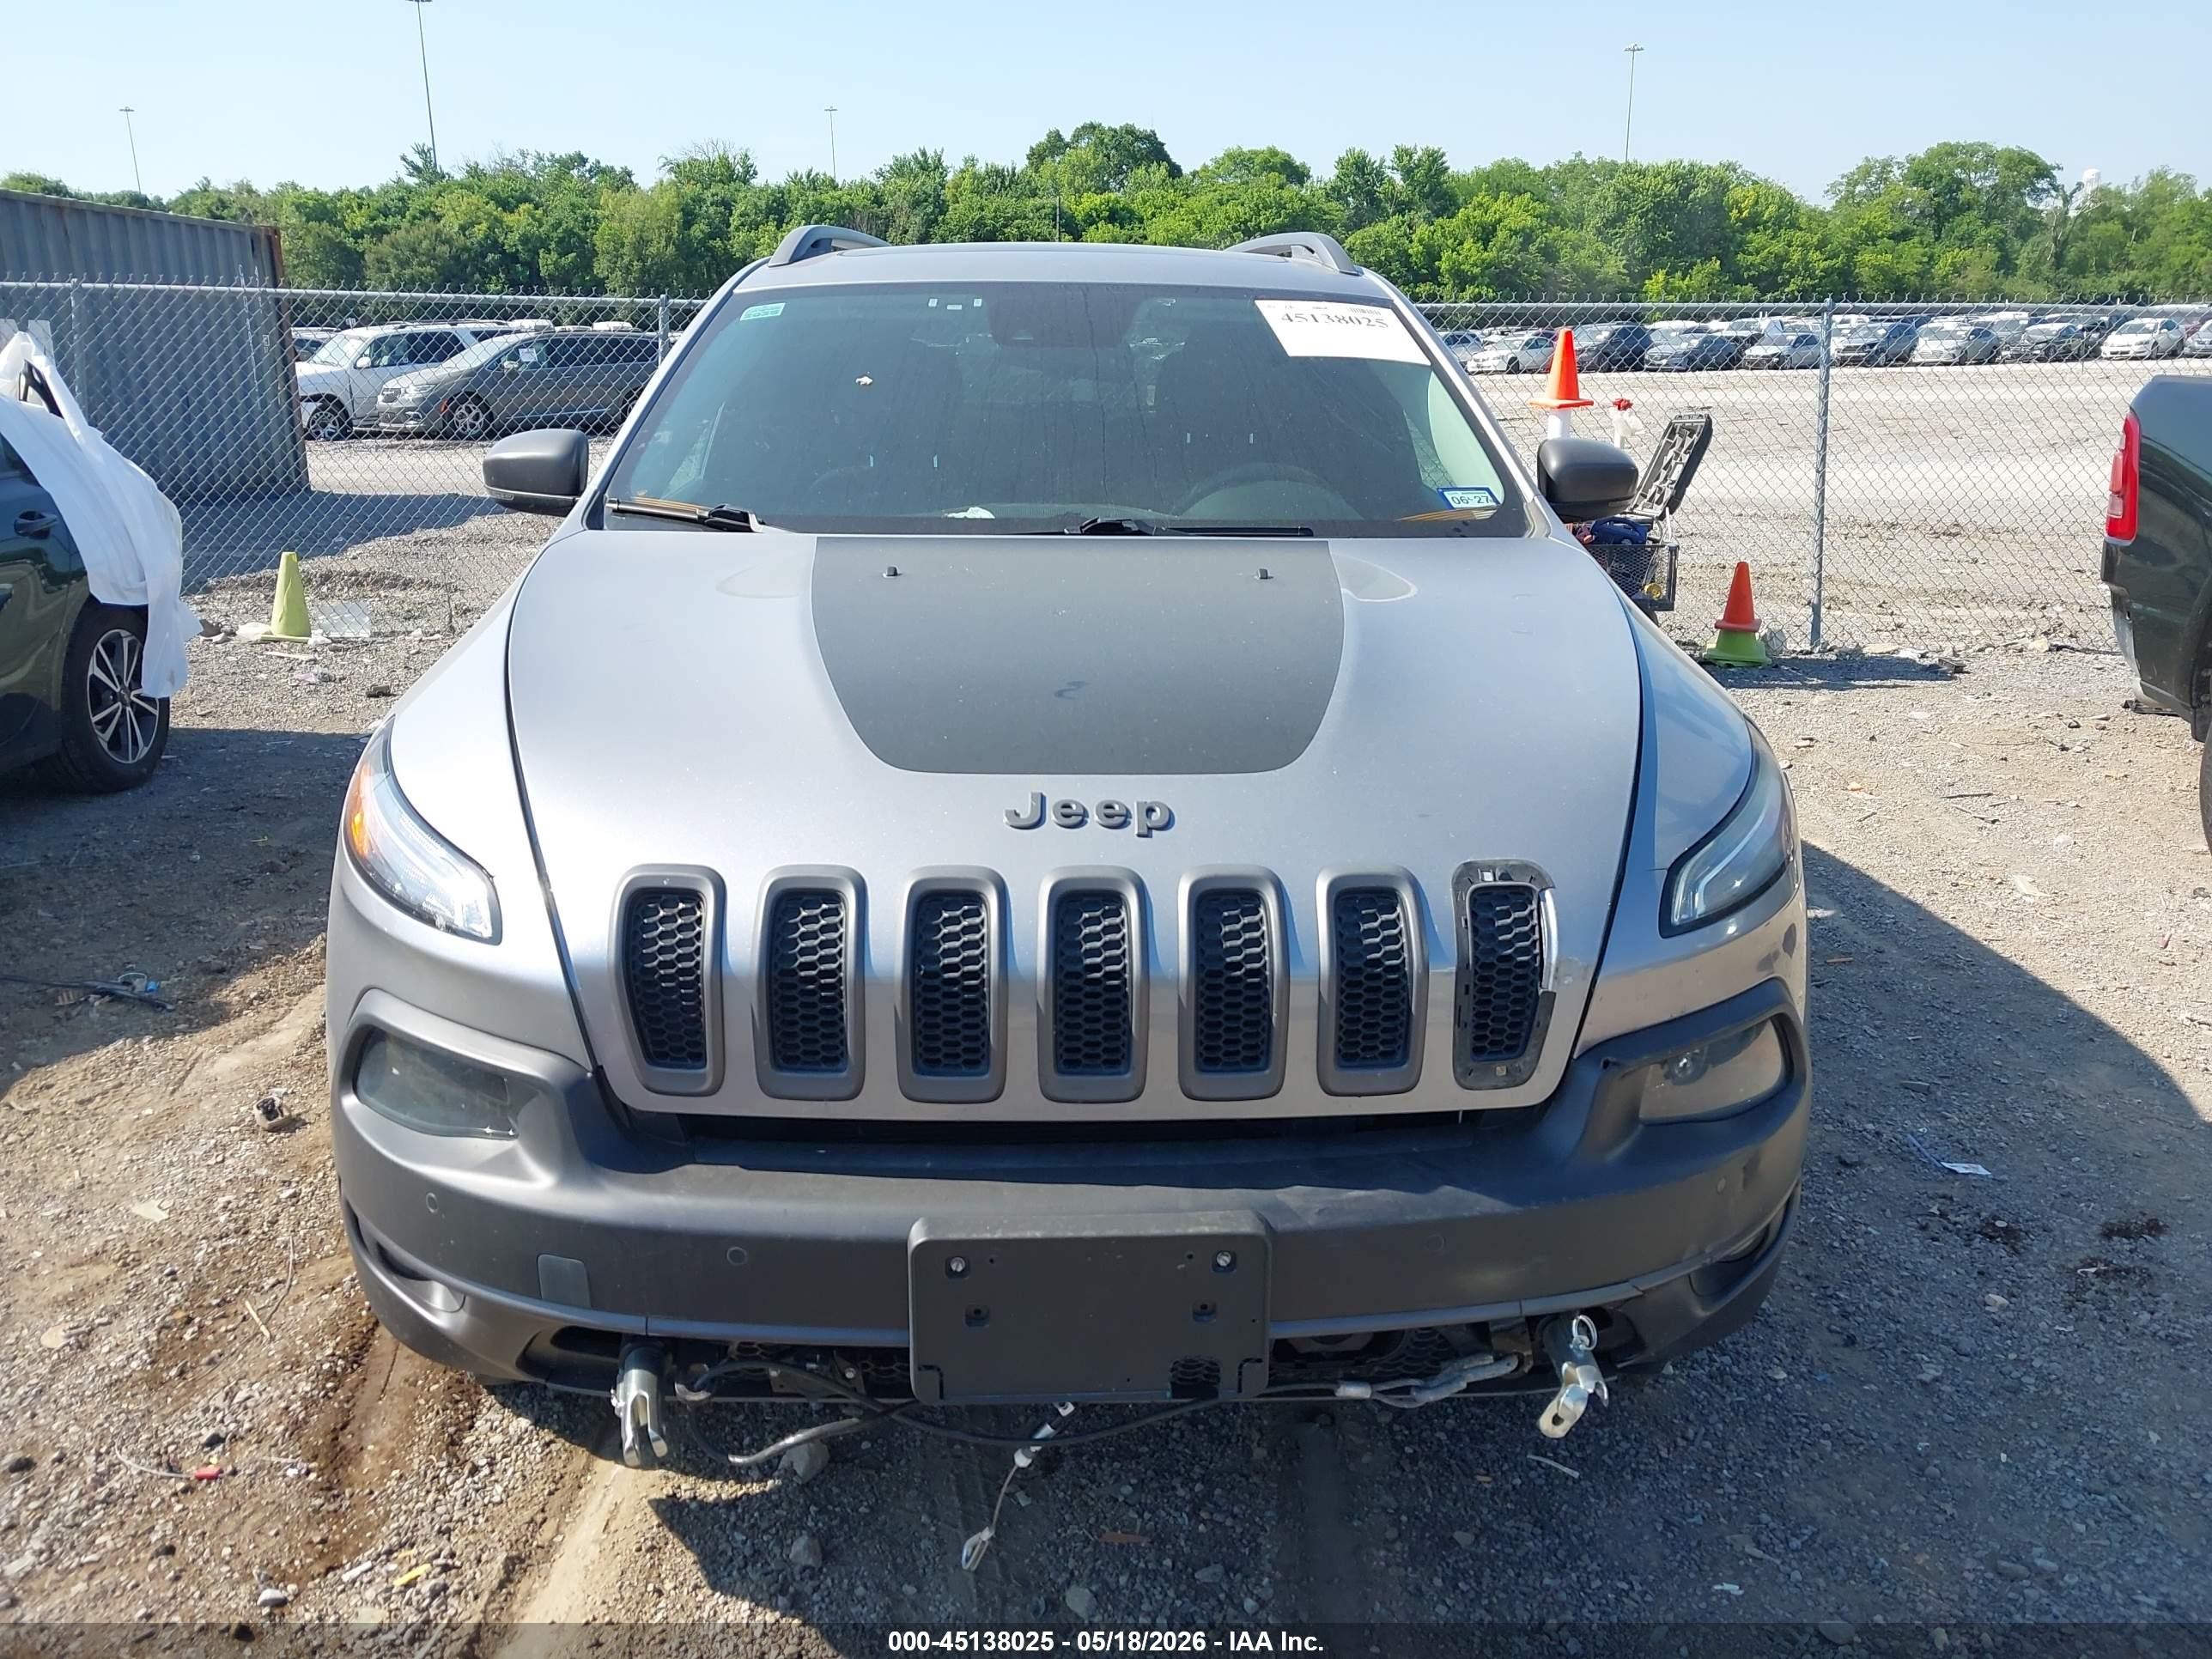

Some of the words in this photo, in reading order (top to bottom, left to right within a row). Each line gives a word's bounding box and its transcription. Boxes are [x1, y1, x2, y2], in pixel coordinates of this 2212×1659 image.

[1281, 313, 1389, 328] 45138025
[1451, 495, 1469, 505] 06
[1474, 495, 1490, 504] 27
[1004, 792, 1175, 838] Jeep
